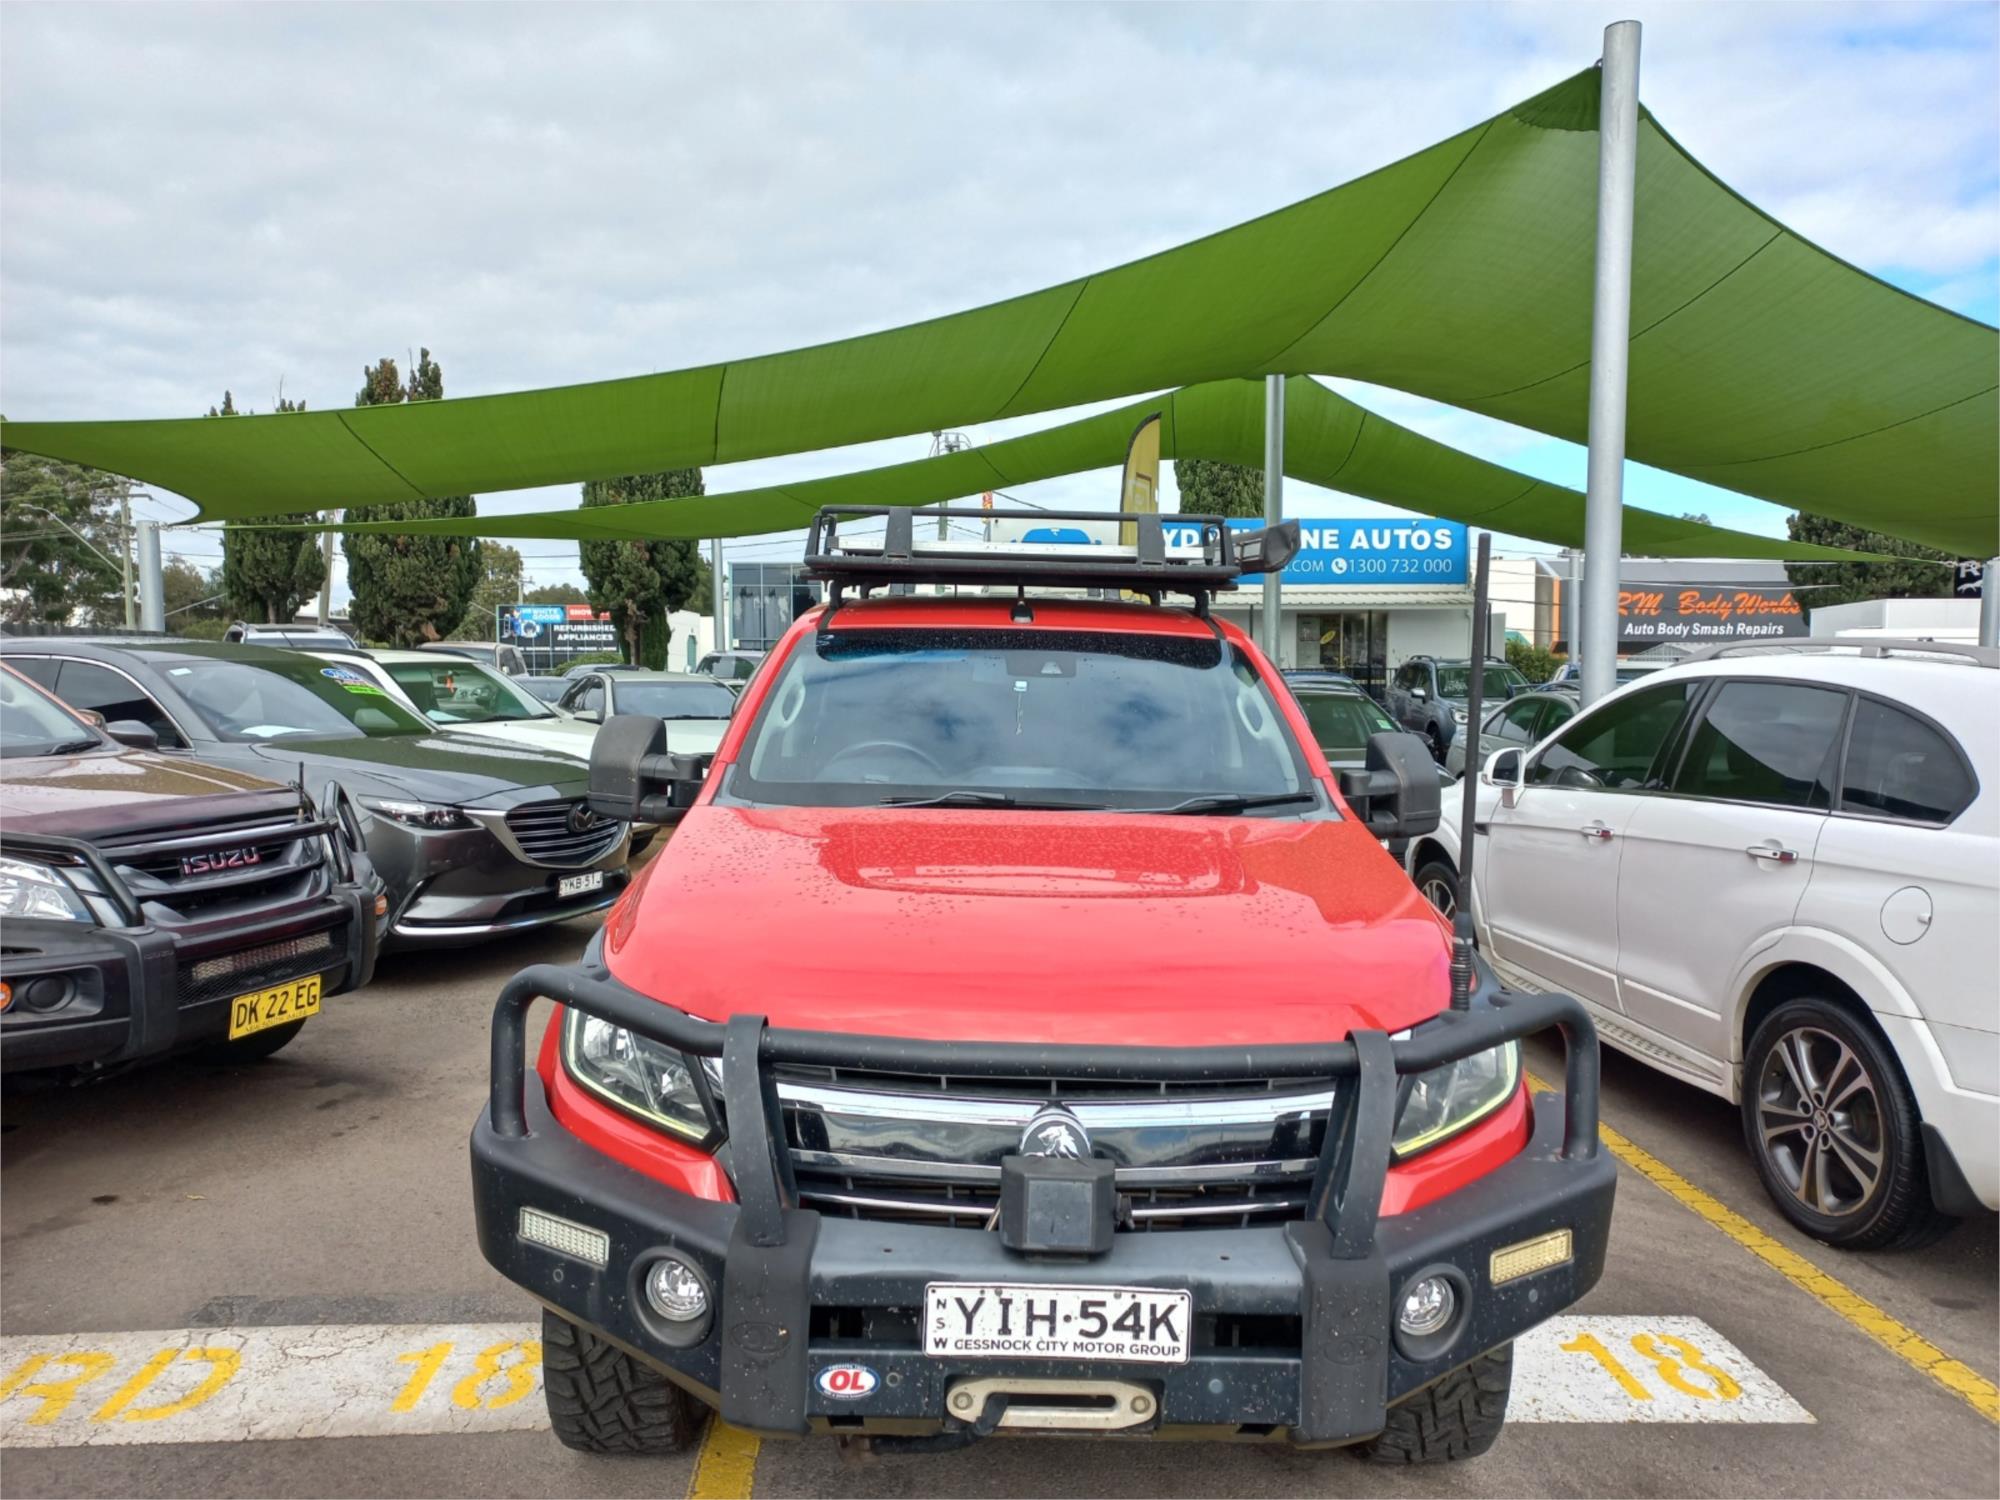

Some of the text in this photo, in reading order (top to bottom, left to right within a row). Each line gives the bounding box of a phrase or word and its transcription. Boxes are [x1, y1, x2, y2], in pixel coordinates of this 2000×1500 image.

[1350, 528, 1452, 550] AUTOS
[1350, 558, 1386, 573] 1300
[1392, 558, 1419, 573] 732
[1424, 558, 1452, 573] 000
[557, 633, 614, 641] APPLIANCES
[1624, 622, 1784, 638] Auto Body Smash Repairs
[182, 847, 259, 876] ISUZU
[1036, 1340, 1069, 1352] CITY
[1073, 1341, 1125, 1354] MOTOR
[1129, 1343, 1181, 1356] GROUP
[1558, 1332, 1743, 1401] 18
[829, 1370, 865, 1391] OL
